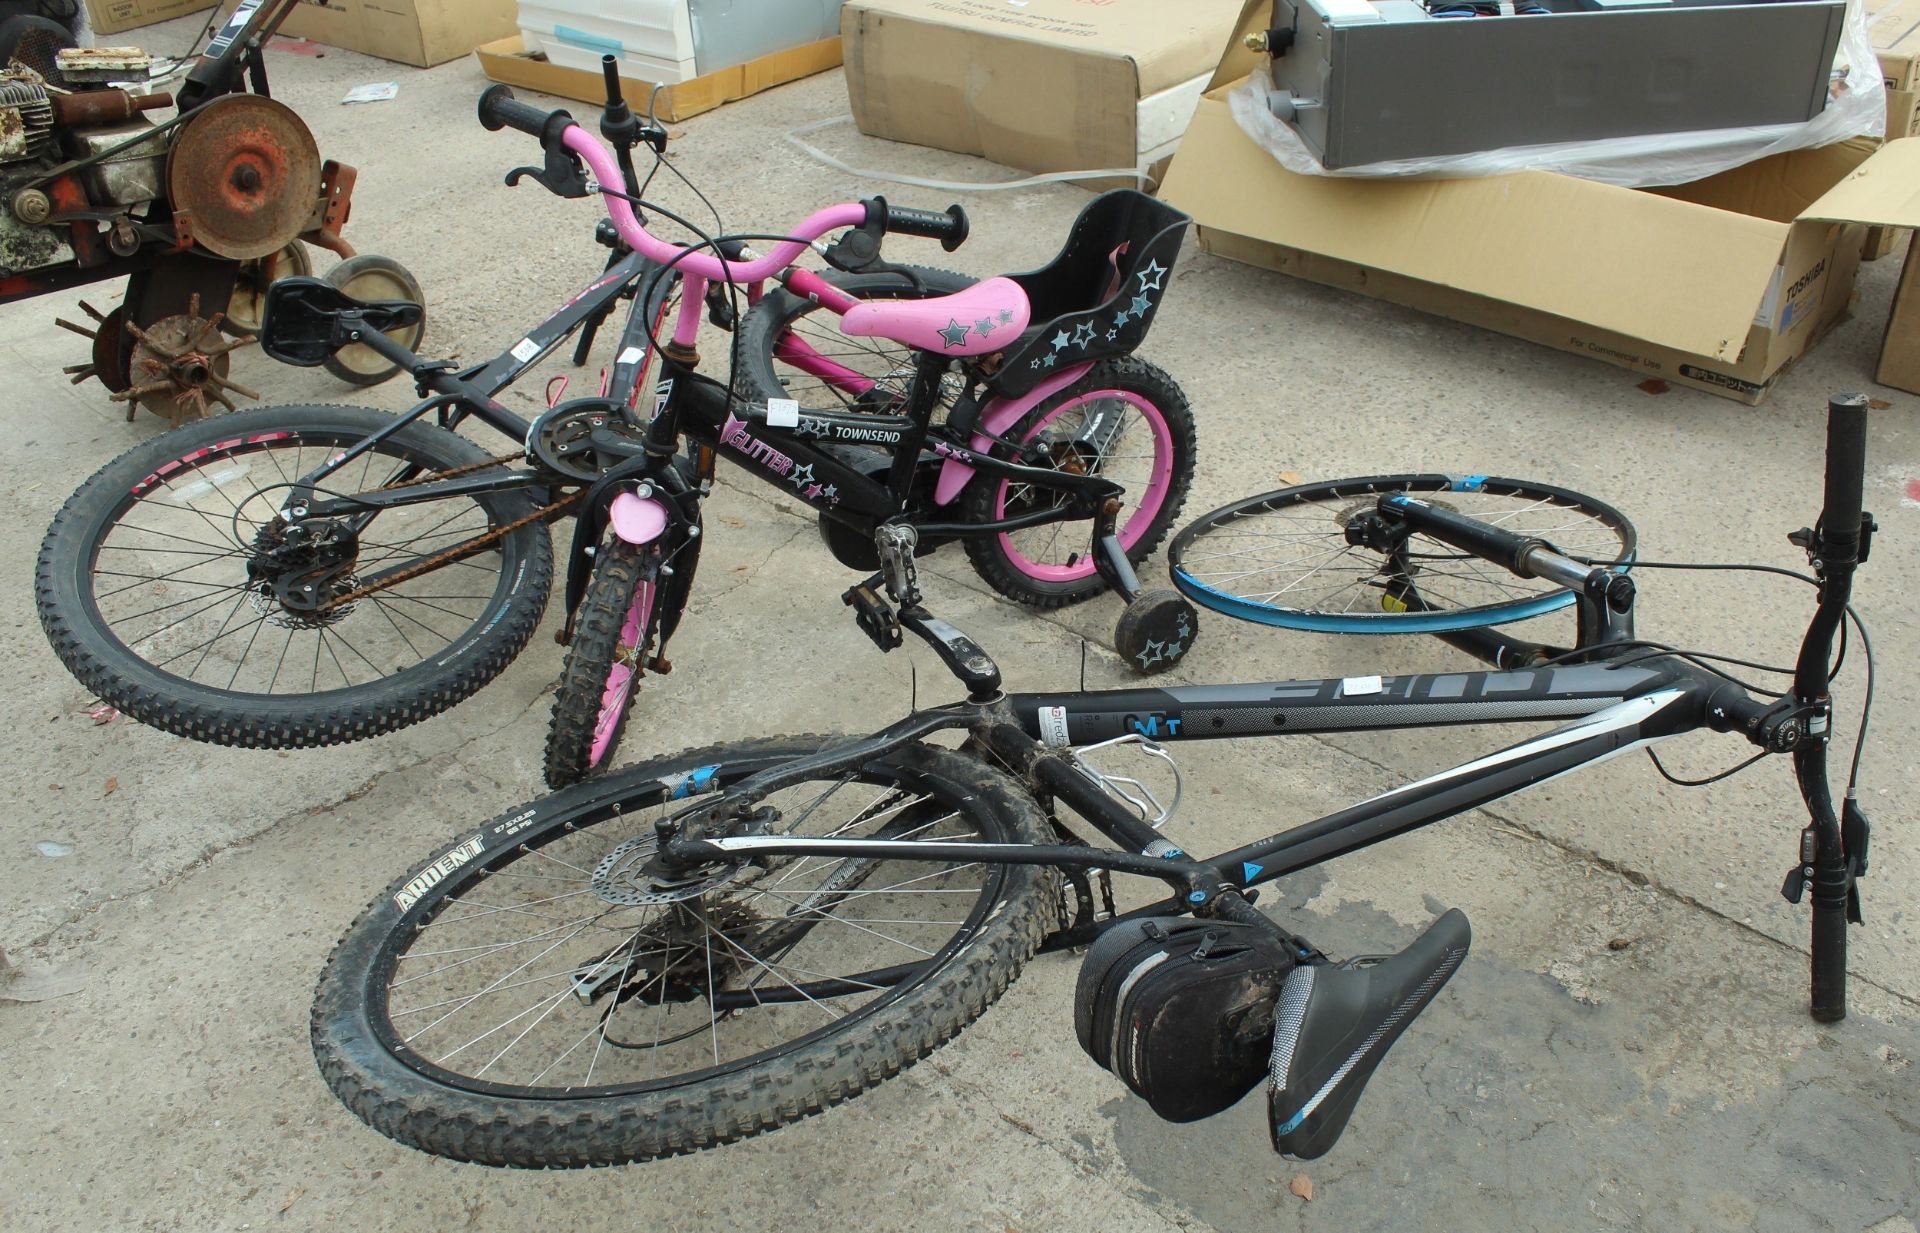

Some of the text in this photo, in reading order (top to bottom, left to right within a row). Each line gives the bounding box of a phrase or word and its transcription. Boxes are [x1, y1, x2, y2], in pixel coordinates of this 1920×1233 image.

[980, 14, 1038, 28] GENERAL
[1786, 257, 1826, 303] TOSHIBA
[1570, 336, 1662, 371] For Commercial Use
[729, 430, 794, 477] GLITTER
[835, 426, 901, 443] TOWNSEND
[394, 833, 486, 913] ARDENT
